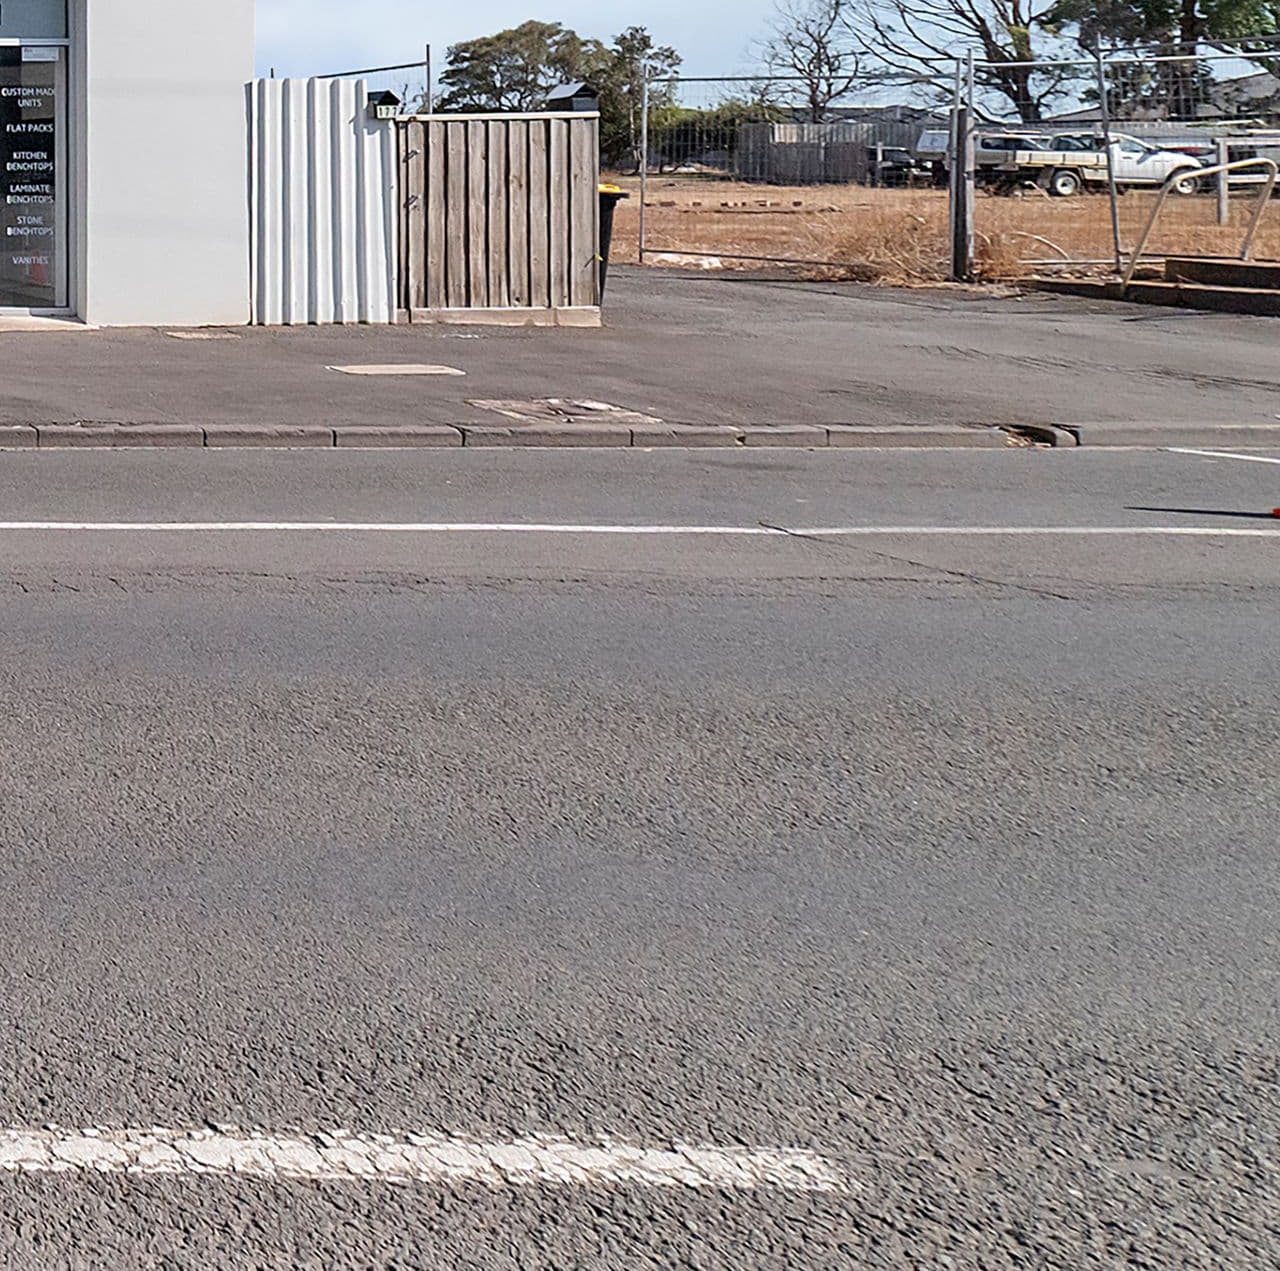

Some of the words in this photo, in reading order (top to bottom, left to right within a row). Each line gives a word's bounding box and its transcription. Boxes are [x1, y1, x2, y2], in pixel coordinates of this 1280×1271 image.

[1, 87, 34, 97] CUSTOM
[36, 87, 57, 97] MAD
[18, 98, 42, 108] UNITS
[378, 106, 397, 117] 177
[6, 123, 27, 133] FLAT
[28, 123, 54, 133] PACKS
[12, 151, 48, 160] KITCHEN
[6, 162, 54, 171] BENCHTOPS
[9, 184, 51, 193] LAMINATE
[6, 195, 54, 204] BENCHTOPS
[16, 215, 44, 225] STONE
[6, 226, 54, 236] BENCHTOPS
[12, 255, 49, 265] VANITIES
